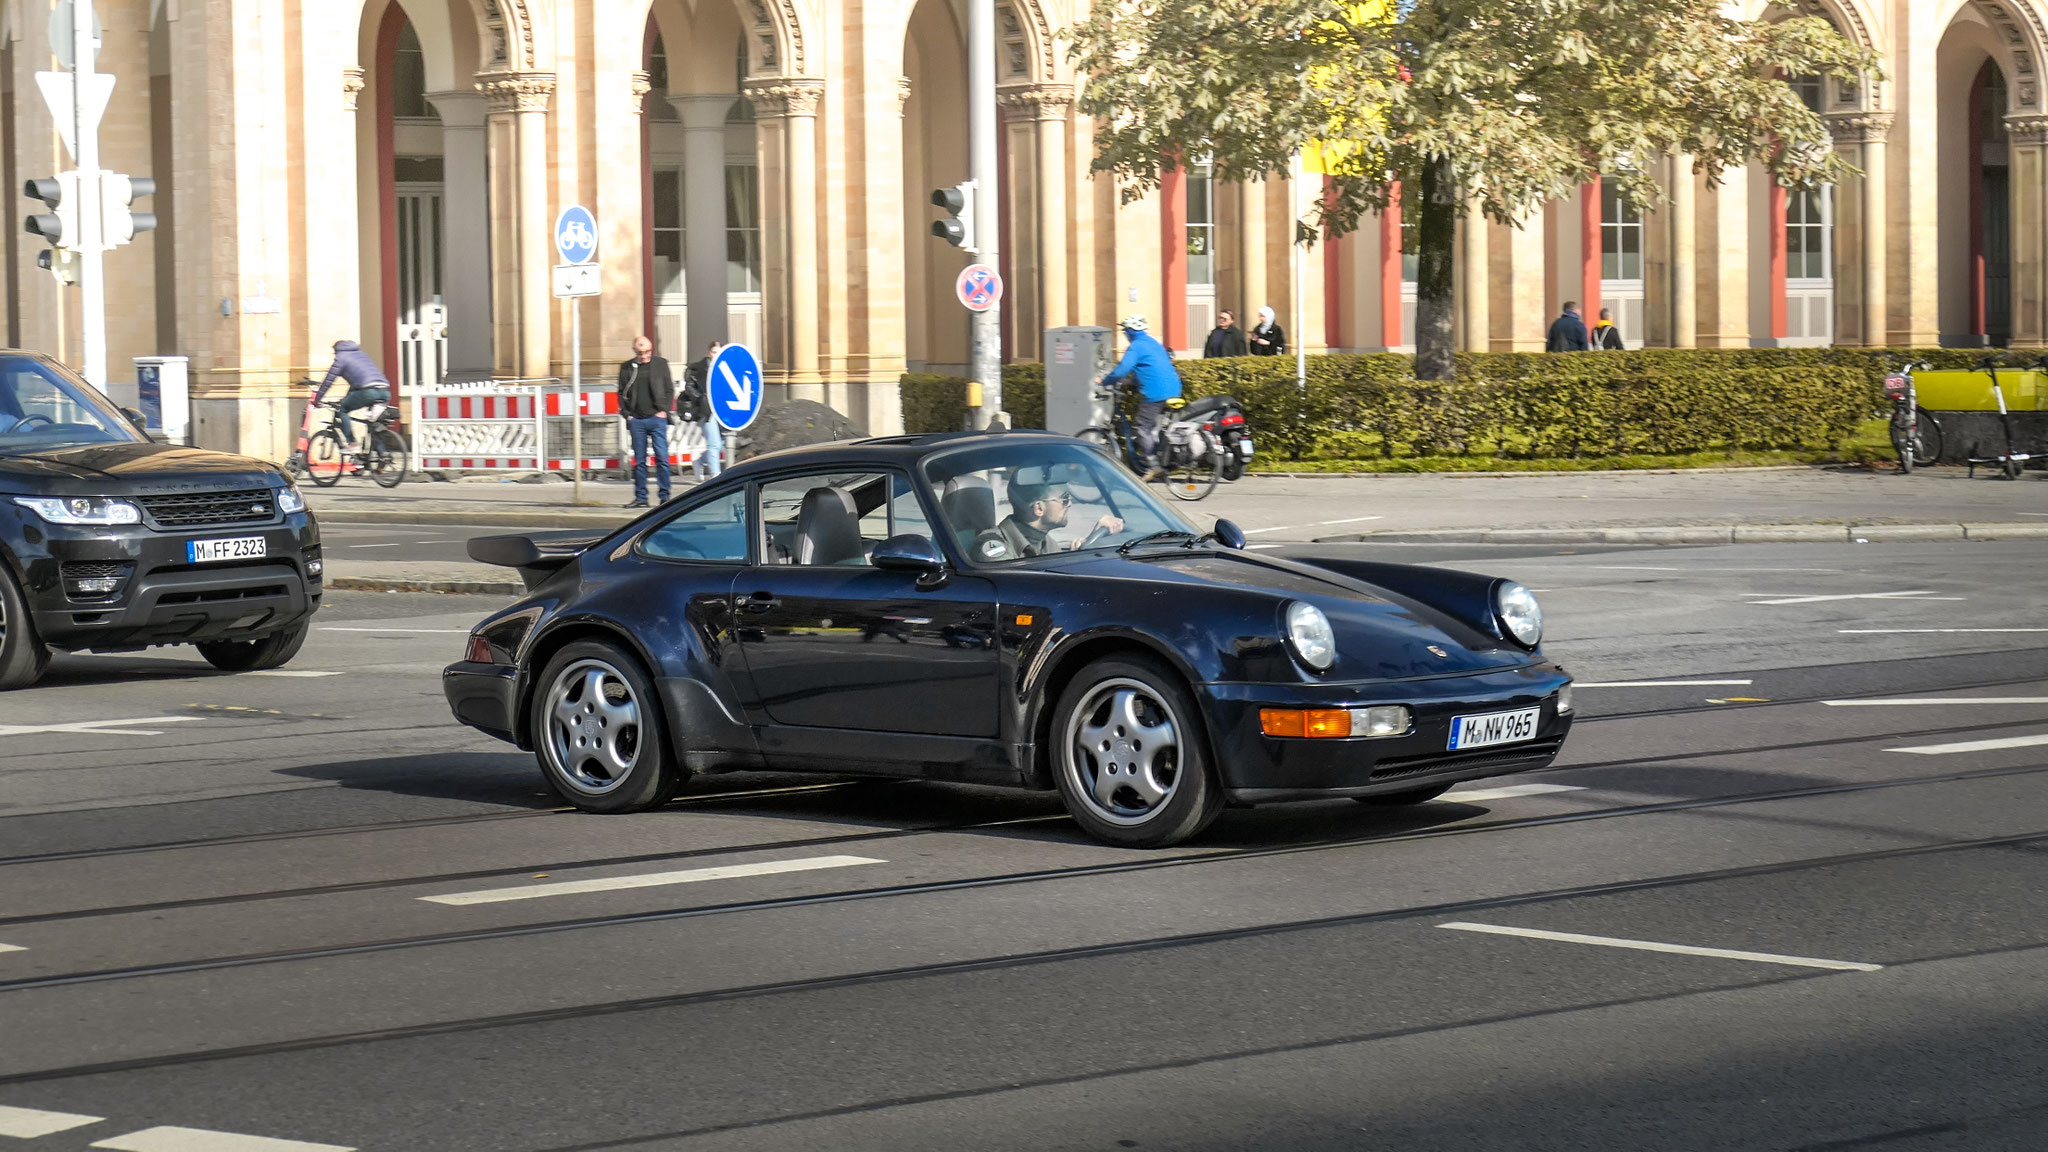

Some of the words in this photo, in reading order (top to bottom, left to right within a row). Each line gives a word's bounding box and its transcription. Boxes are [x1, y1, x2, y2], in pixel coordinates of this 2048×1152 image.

[196, 543, 206, 559] M
[214, 541, 231, 557] FF
[233, 539, 265, 556] 2323
[1463, 719, 1477, 744] M
[1506, 712, 1533, 739] 965
